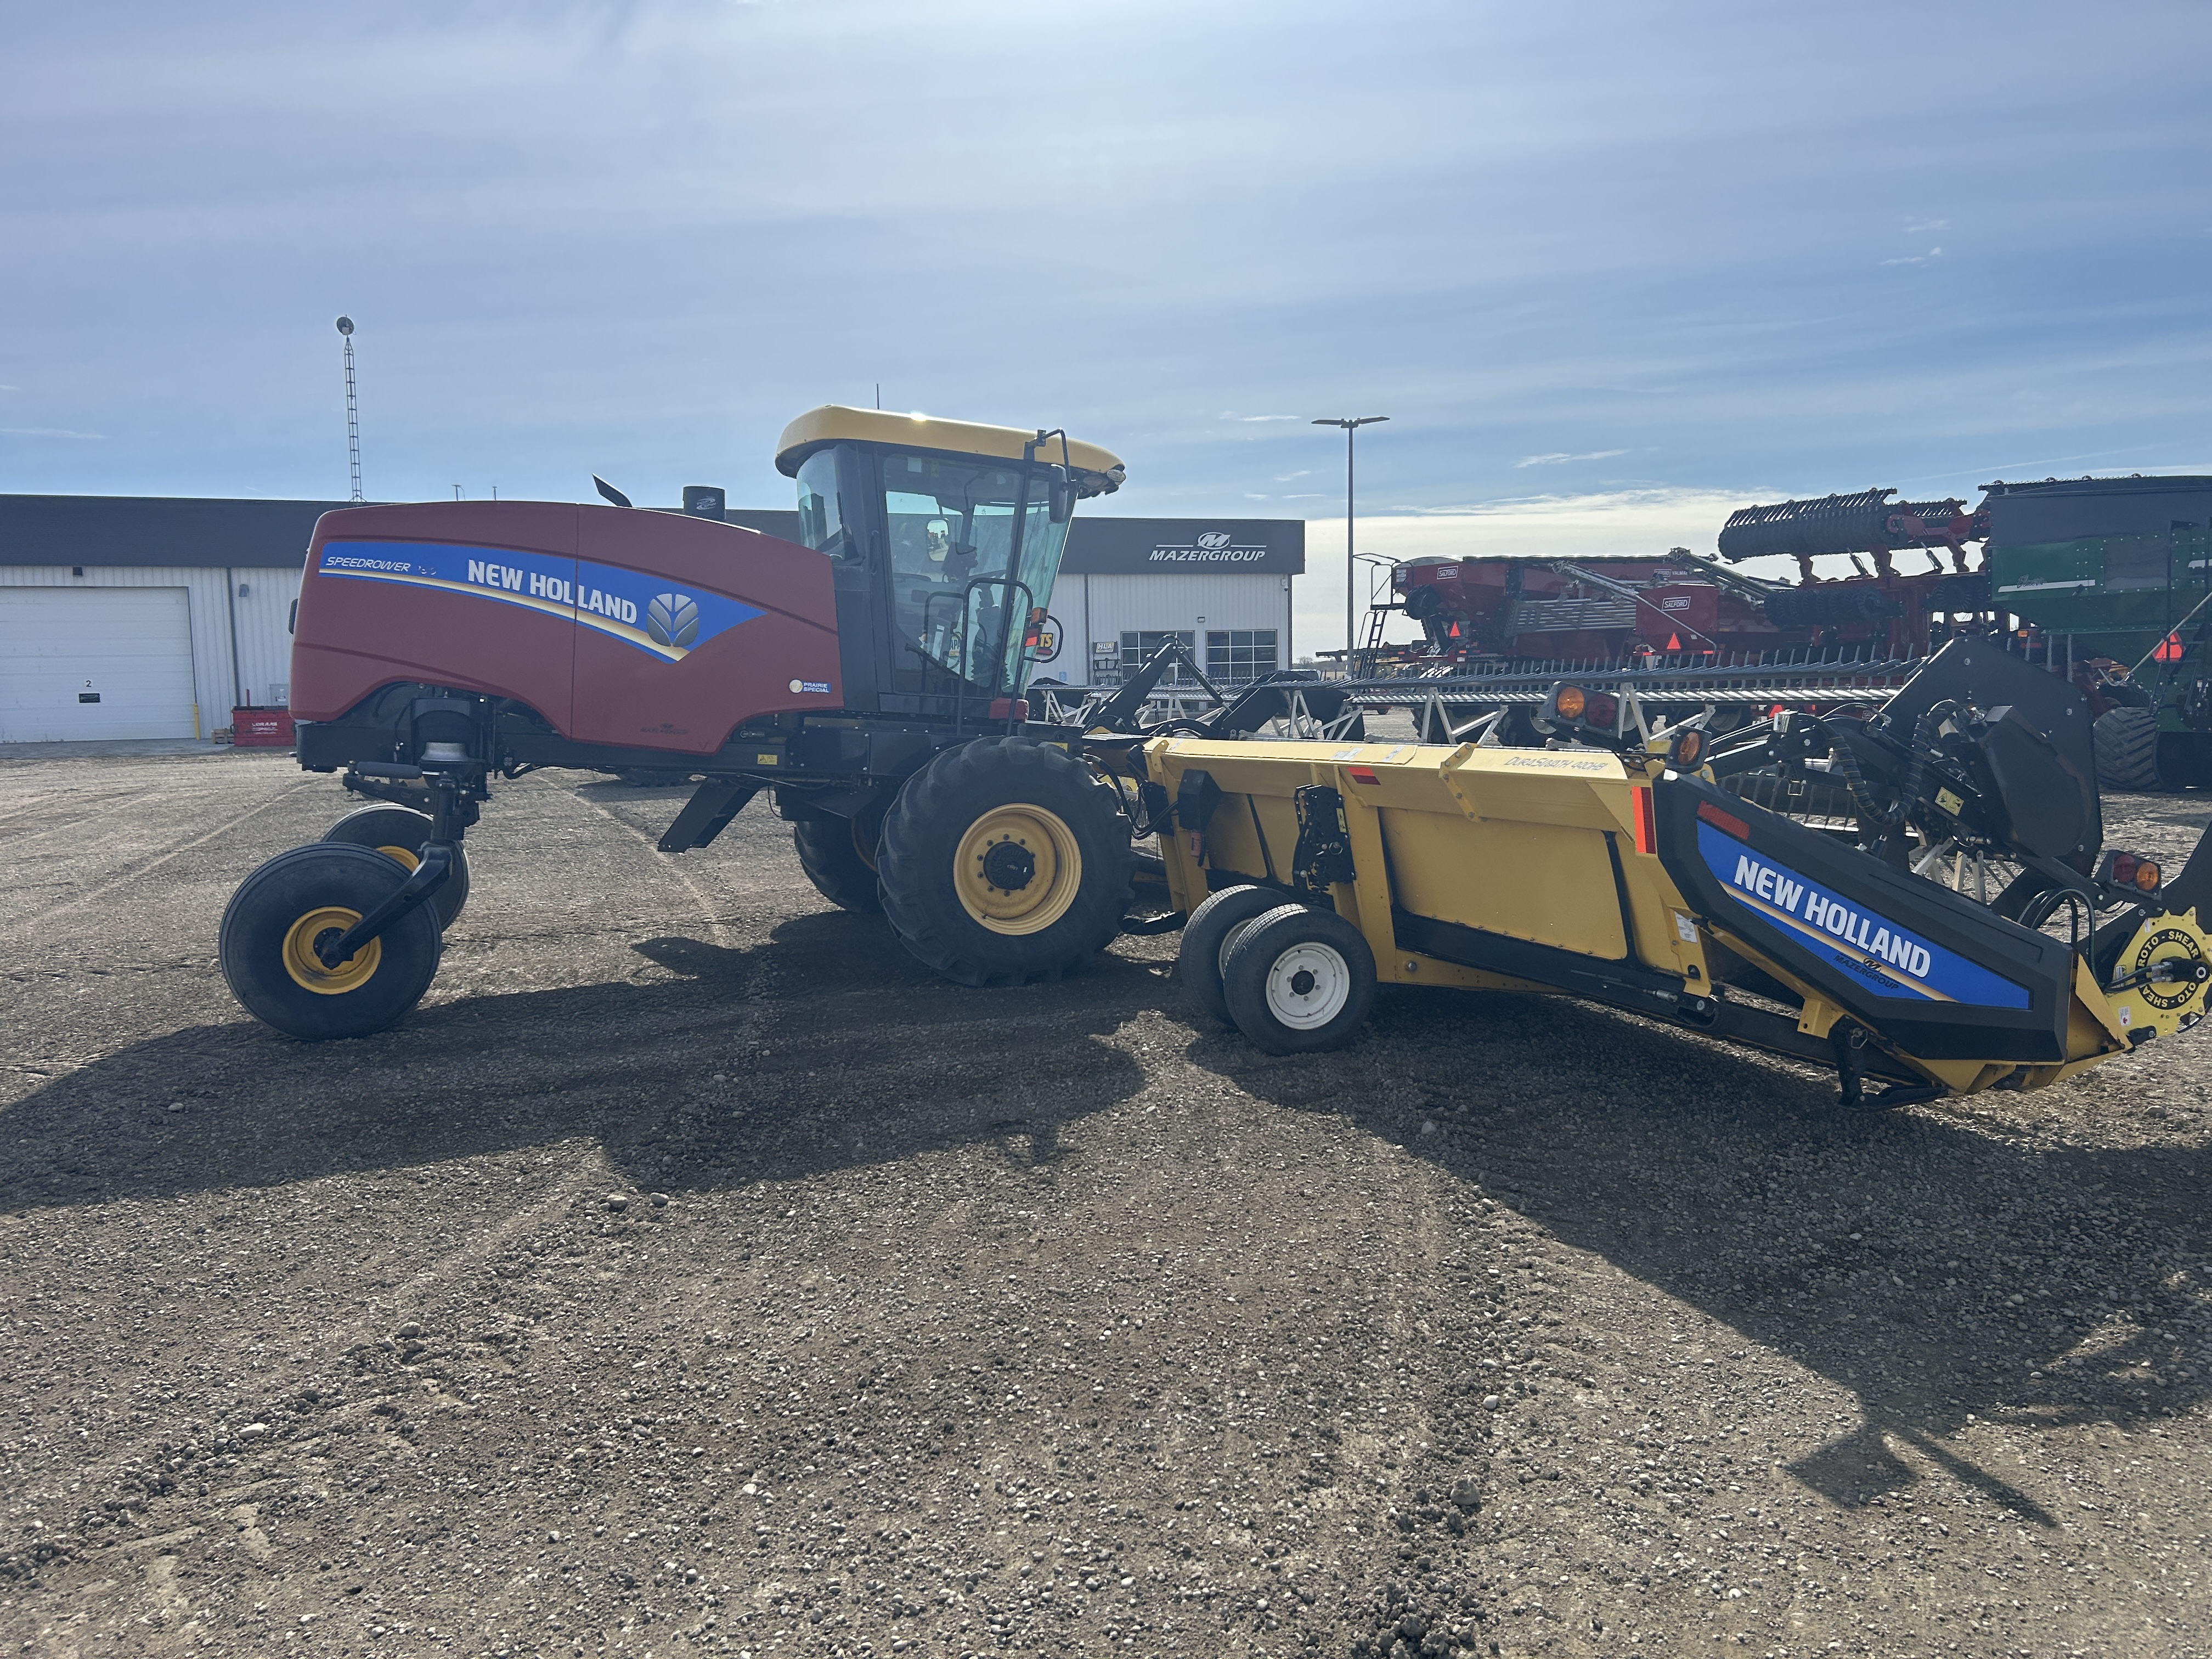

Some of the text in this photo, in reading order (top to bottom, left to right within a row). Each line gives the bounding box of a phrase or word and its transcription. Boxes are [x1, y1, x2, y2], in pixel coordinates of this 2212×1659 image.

[326, 556, 411, 572] SPEEDROWER
[1149, 550, 1266, 561] MAZERGROUP
[468, 559, 637, 624] NEW HOLLAND
[1664, 599, 1688, 608] SALFORD
[1734, 855, 1931, 978] NEW HOLLAND
[1834, 955, 1899, 989] MAZERGROUP
[2141, 985, 2168, 1007] SHEA
[2178, 982, 2196, 1003] OTO
